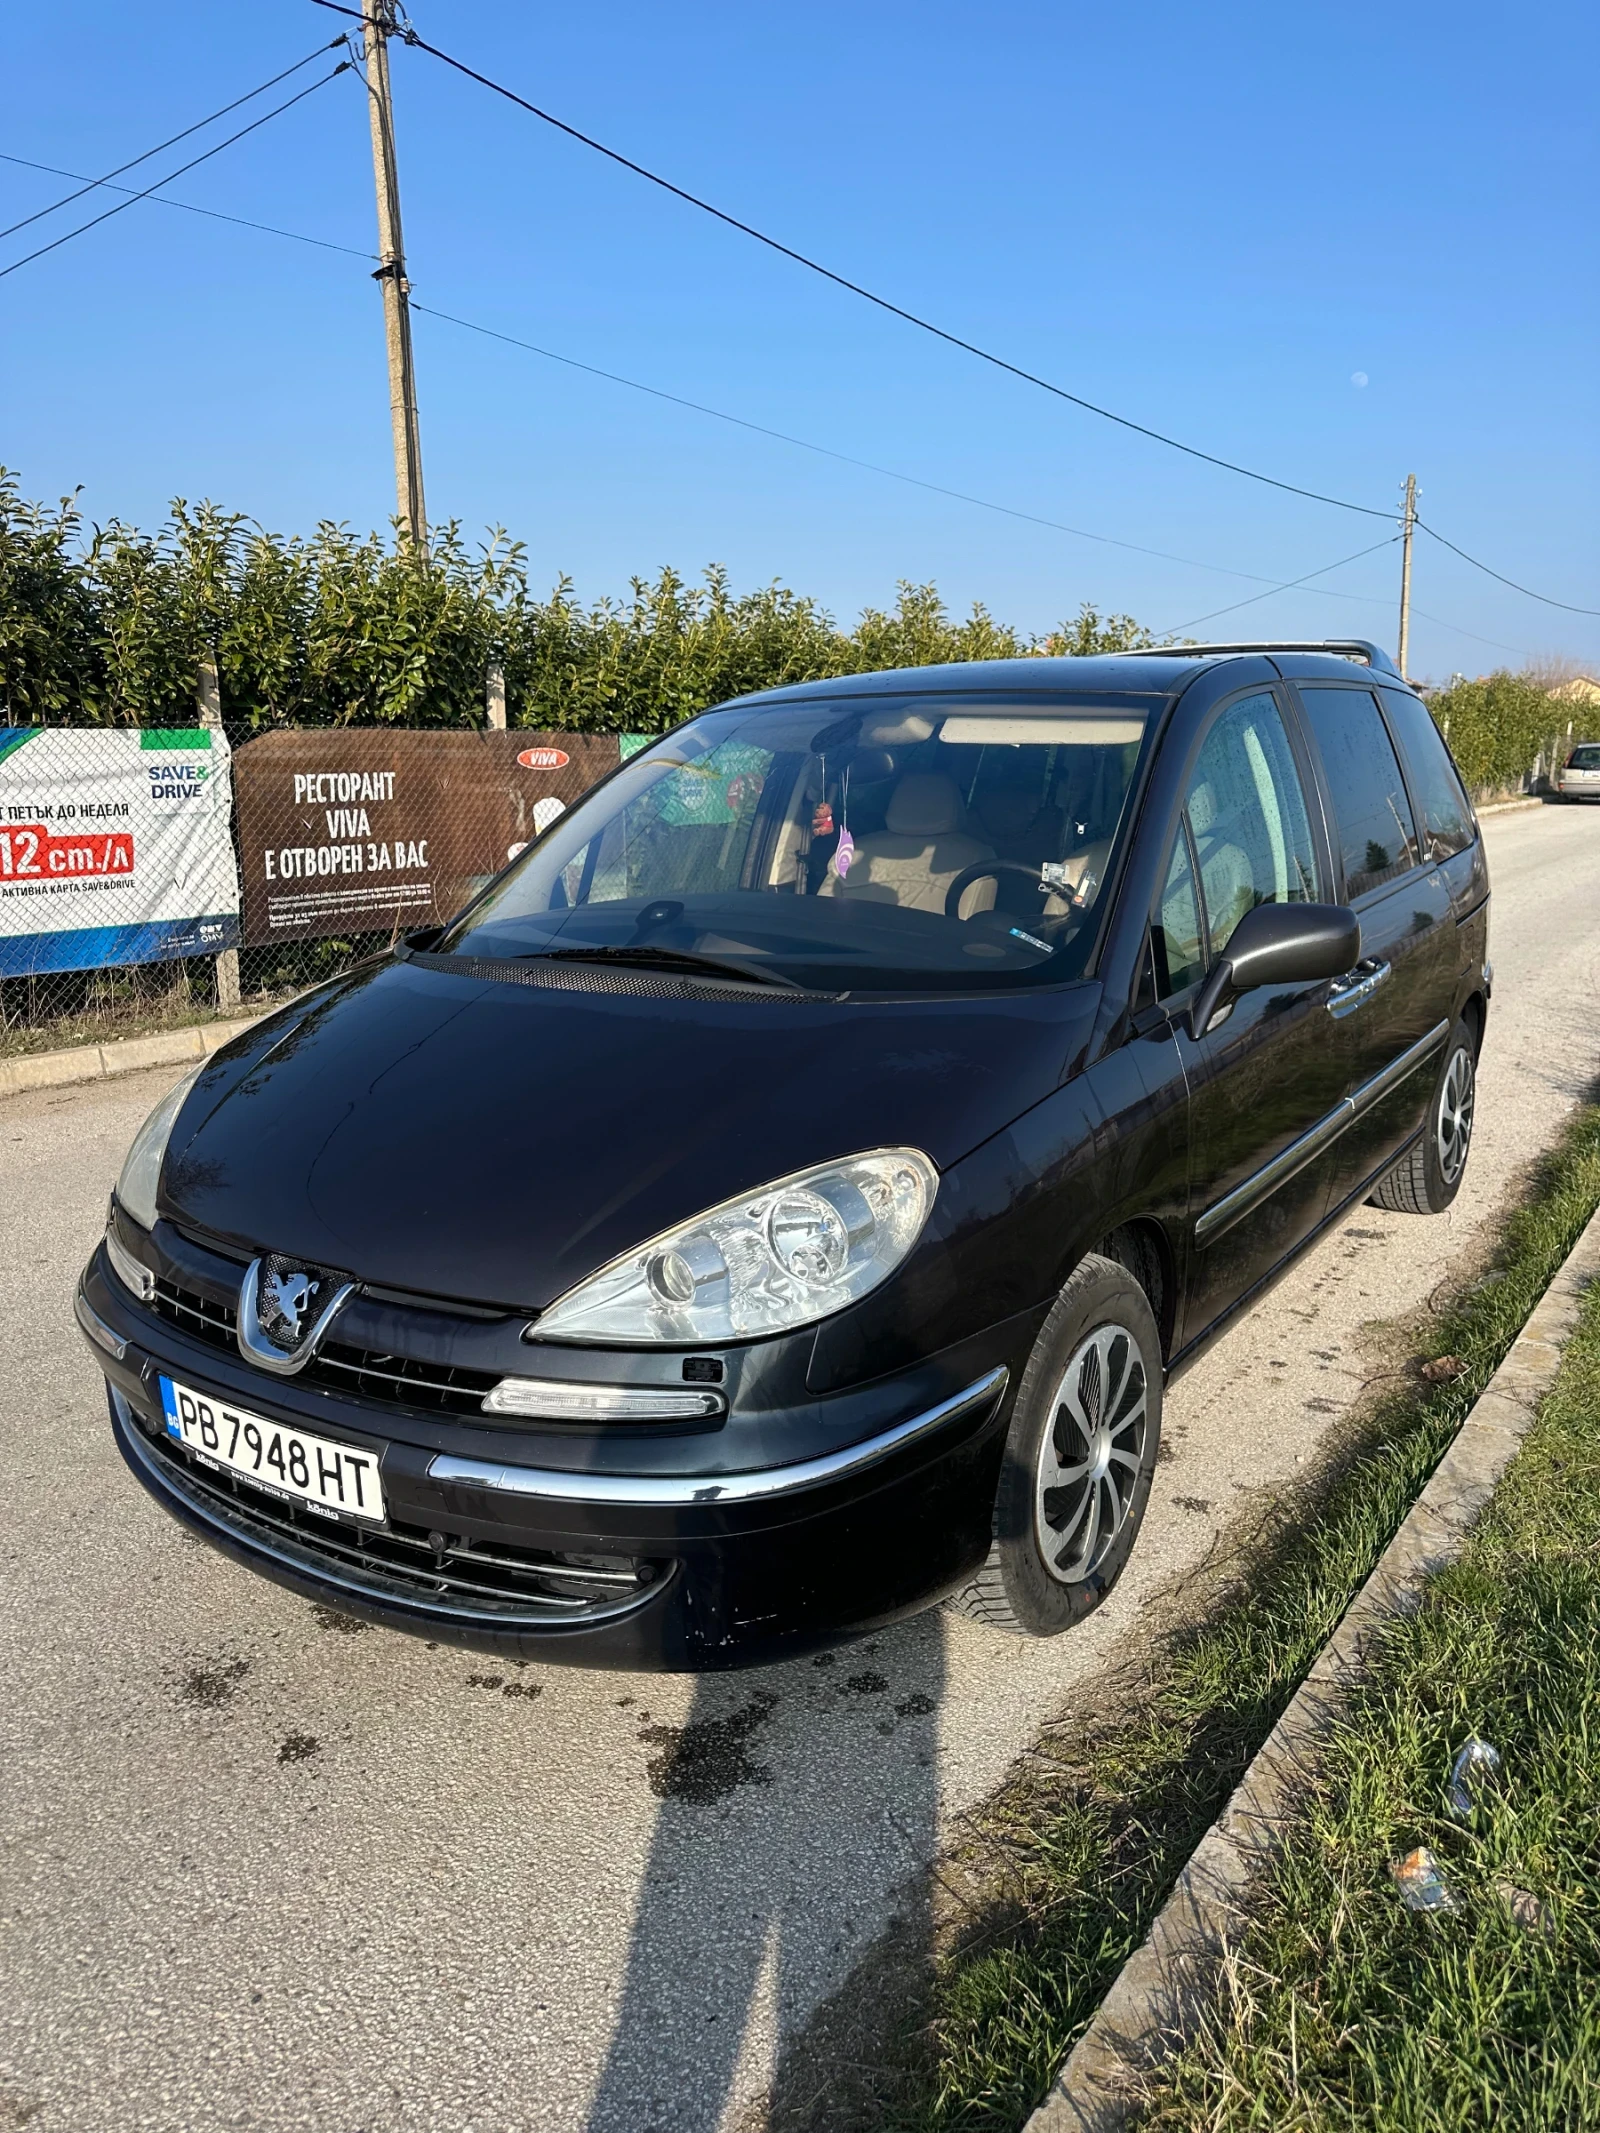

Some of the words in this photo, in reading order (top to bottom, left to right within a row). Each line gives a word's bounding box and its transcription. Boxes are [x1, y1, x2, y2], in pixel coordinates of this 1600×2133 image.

[530, 751, 558, 766] VIVA
[149, 765, 209, 780] SAVE&
[151, 784, 203, 799] DRIVE
[294, 771, 396, 804] РЕСТОРАНТ
[8, 805, 54, 820] ПЕТЪК
[57, 804, 76, 820] ДО
[80, 803, 129, 819] НЕДЕЛЯ
[325, 808, 371, 839] VIVA
[265, 849, 276, 880] Е
[280, 843, 364, 879] ОТВОРЕН
[367, 842, 392, 871] ЗА
[395, 840, 428, 869] ВАС
[2, 885, 48, 898] АКТИВНА
[50, 883, 80, 895] КАРТА
[82, 879, 136, 892] SAVE&DRIVE
[166, 1412, 180, 1430] BG
[222, 1412, 310, 1489] 7948
